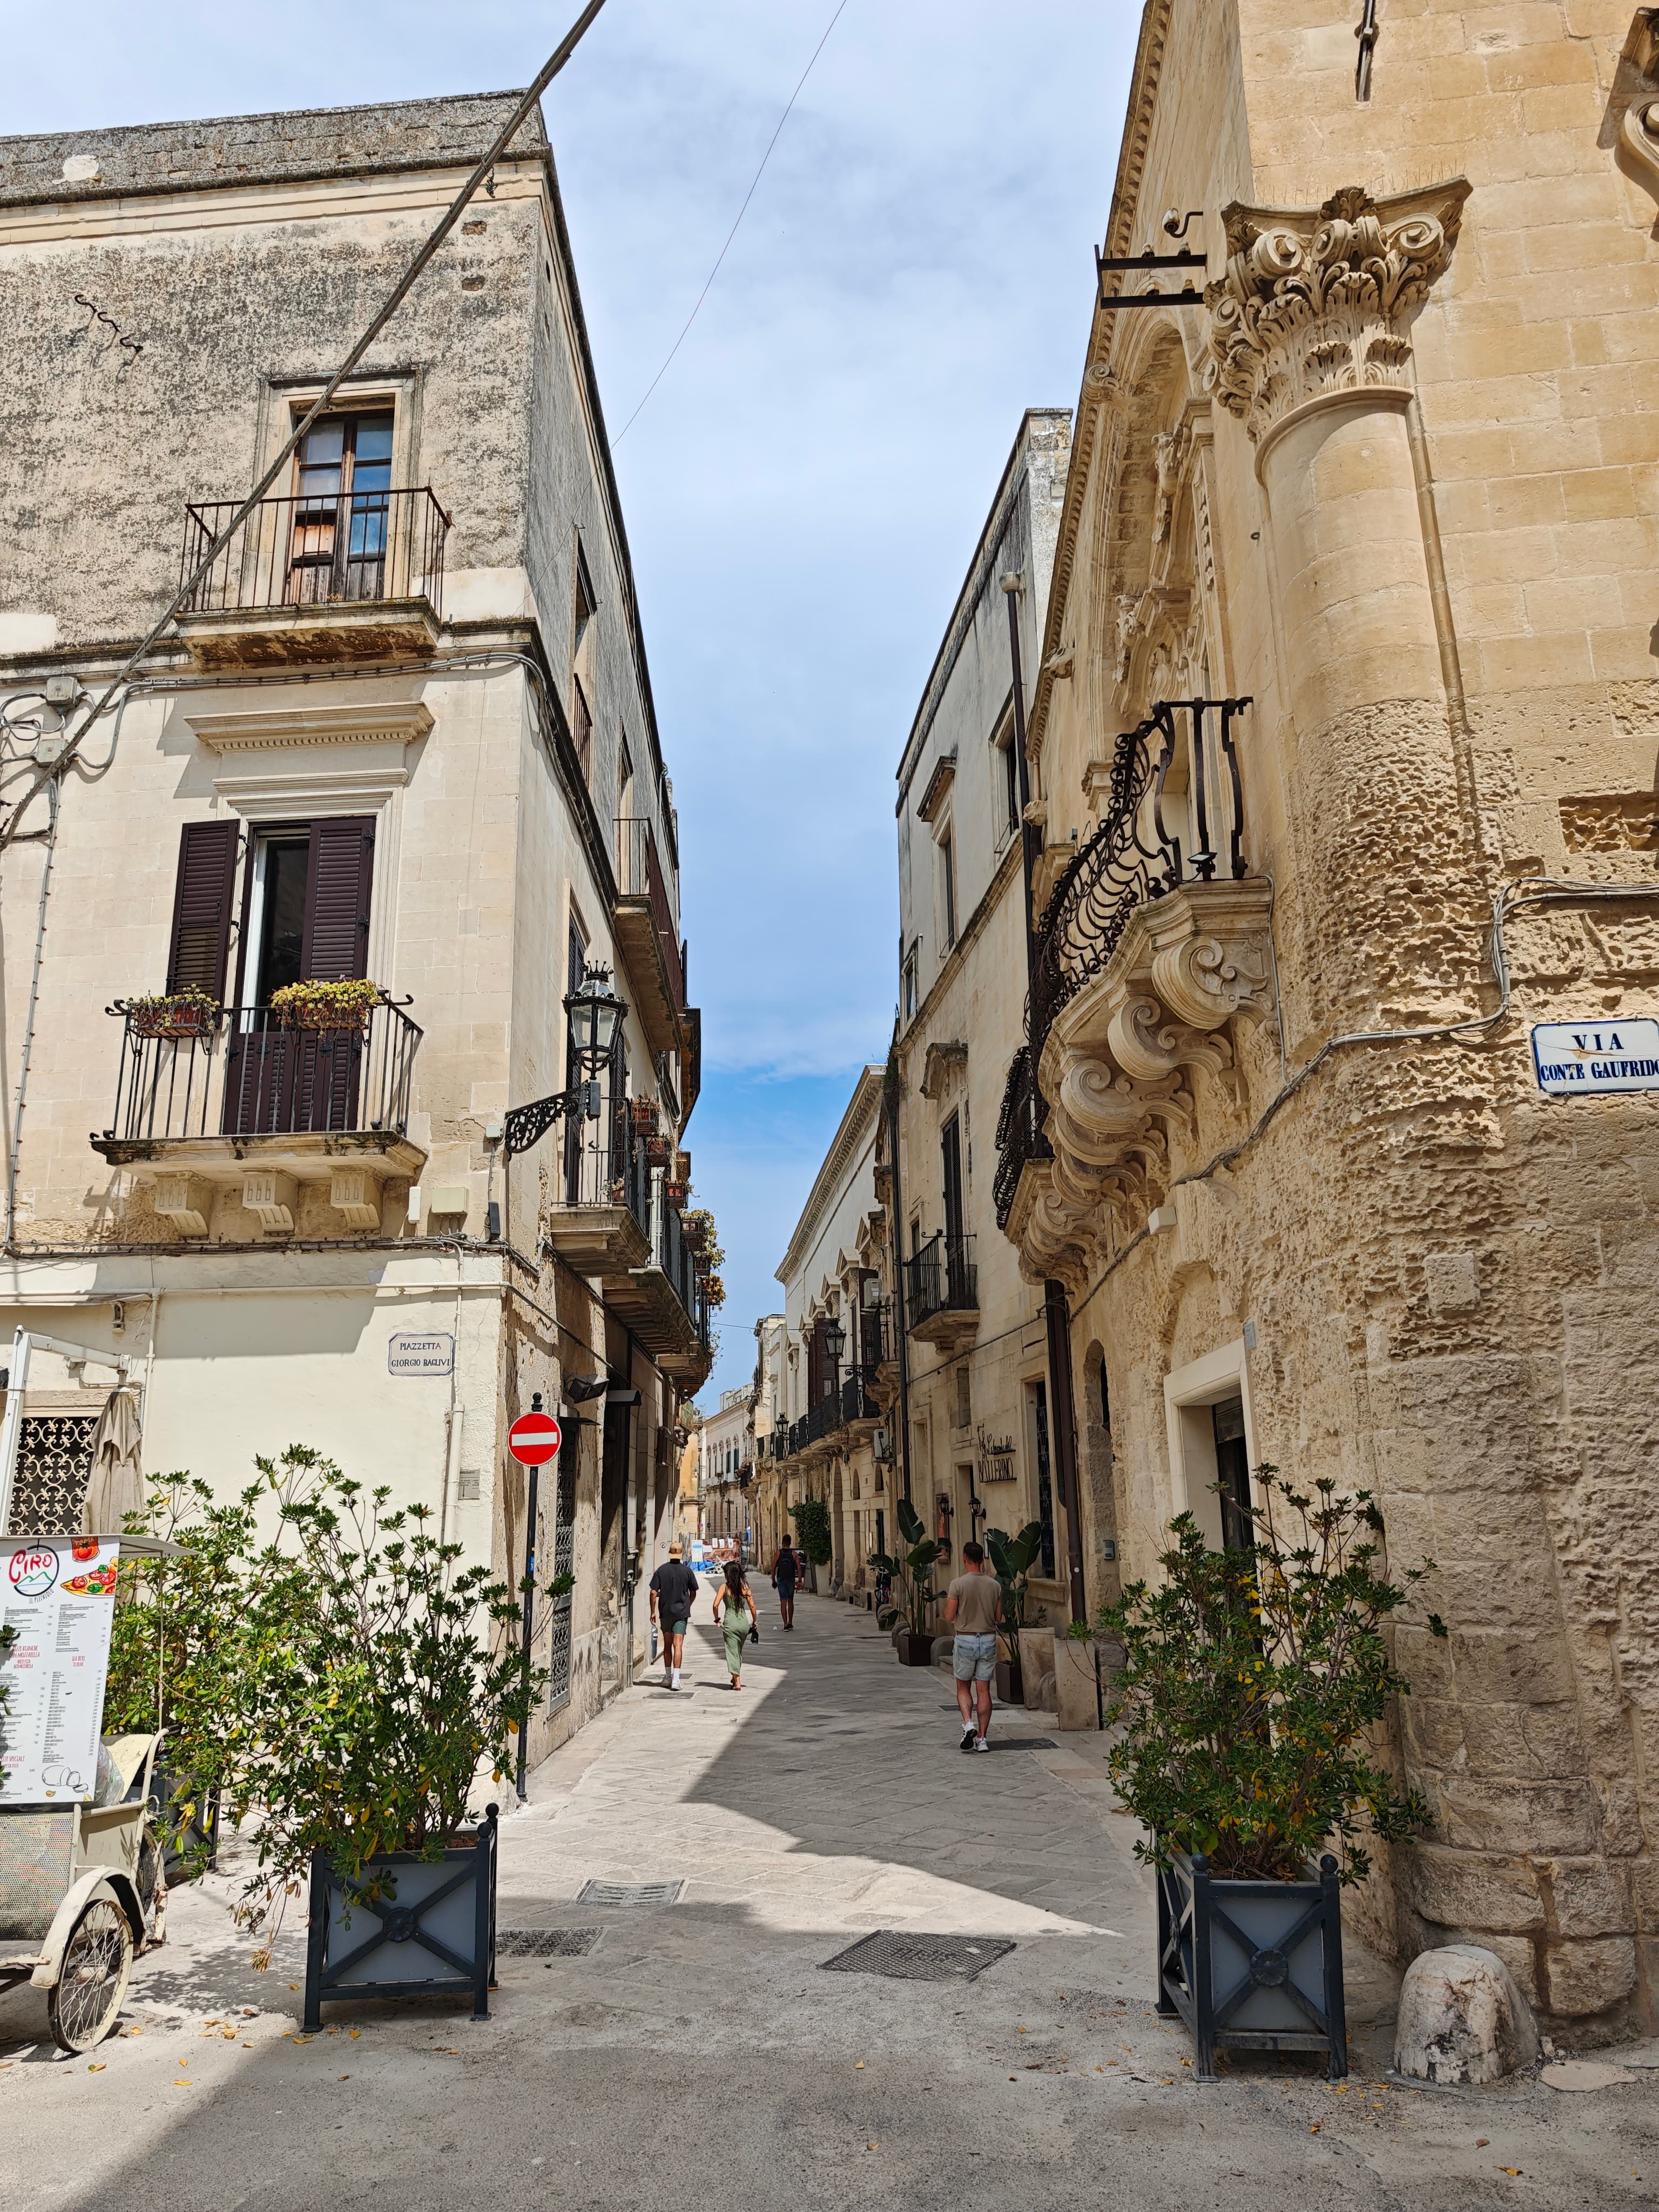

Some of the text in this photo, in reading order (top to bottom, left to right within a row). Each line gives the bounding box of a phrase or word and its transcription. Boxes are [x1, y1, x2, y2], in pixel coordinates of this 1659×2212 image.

[1572, 1033, 1624, 1050] VIA
[1541, 1063, 1585, 1081] CONTE
[392, 1359, 420, 1367] GIORGIO
[978, 1457, 1014, 1482] BALLERINO
[9, 1549, 52, 1583] CIRO
